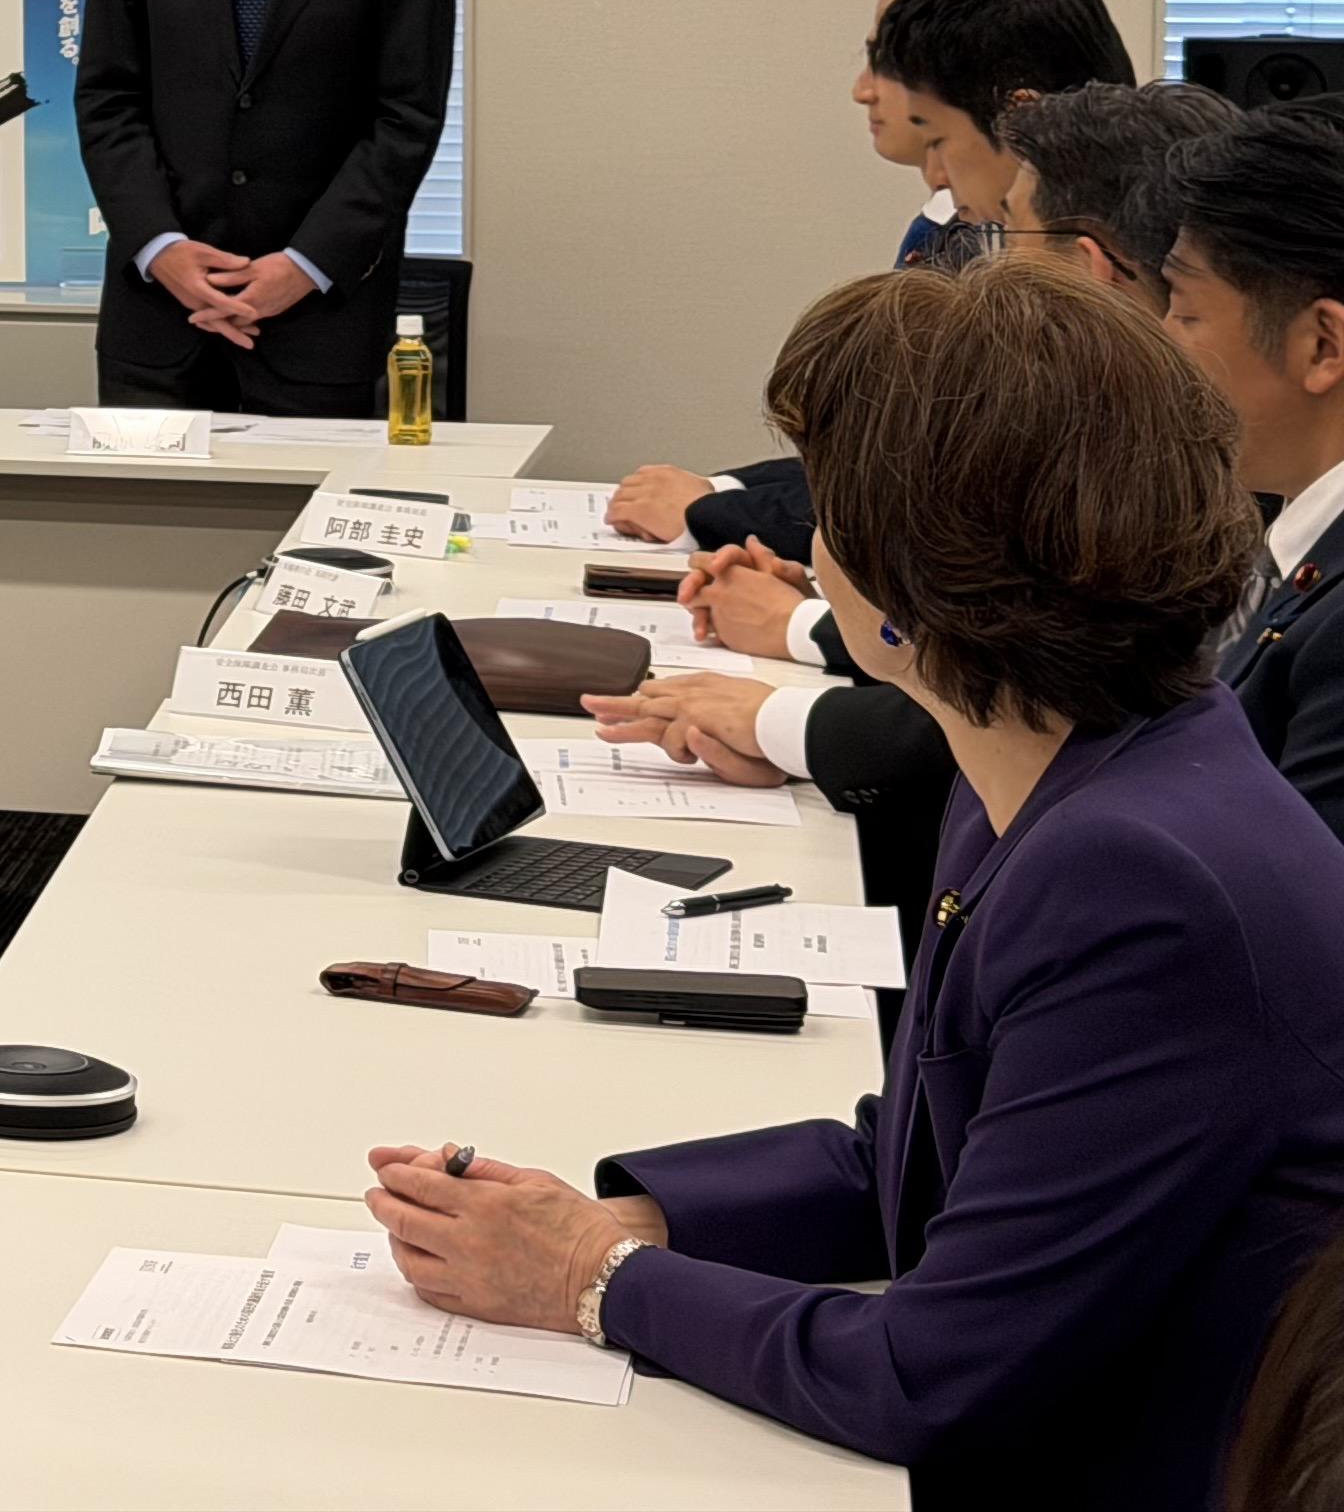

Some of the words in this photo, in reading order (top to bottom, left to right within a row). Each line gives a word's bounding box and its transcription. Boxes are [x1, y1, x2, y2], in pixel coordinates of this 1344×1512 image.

[323, 516, 373, 543] 阿部
[376, 523, 425, 550] 圭史
[215, 680, 274, 711] 西田
[284, 687, 316, 717] 薫
